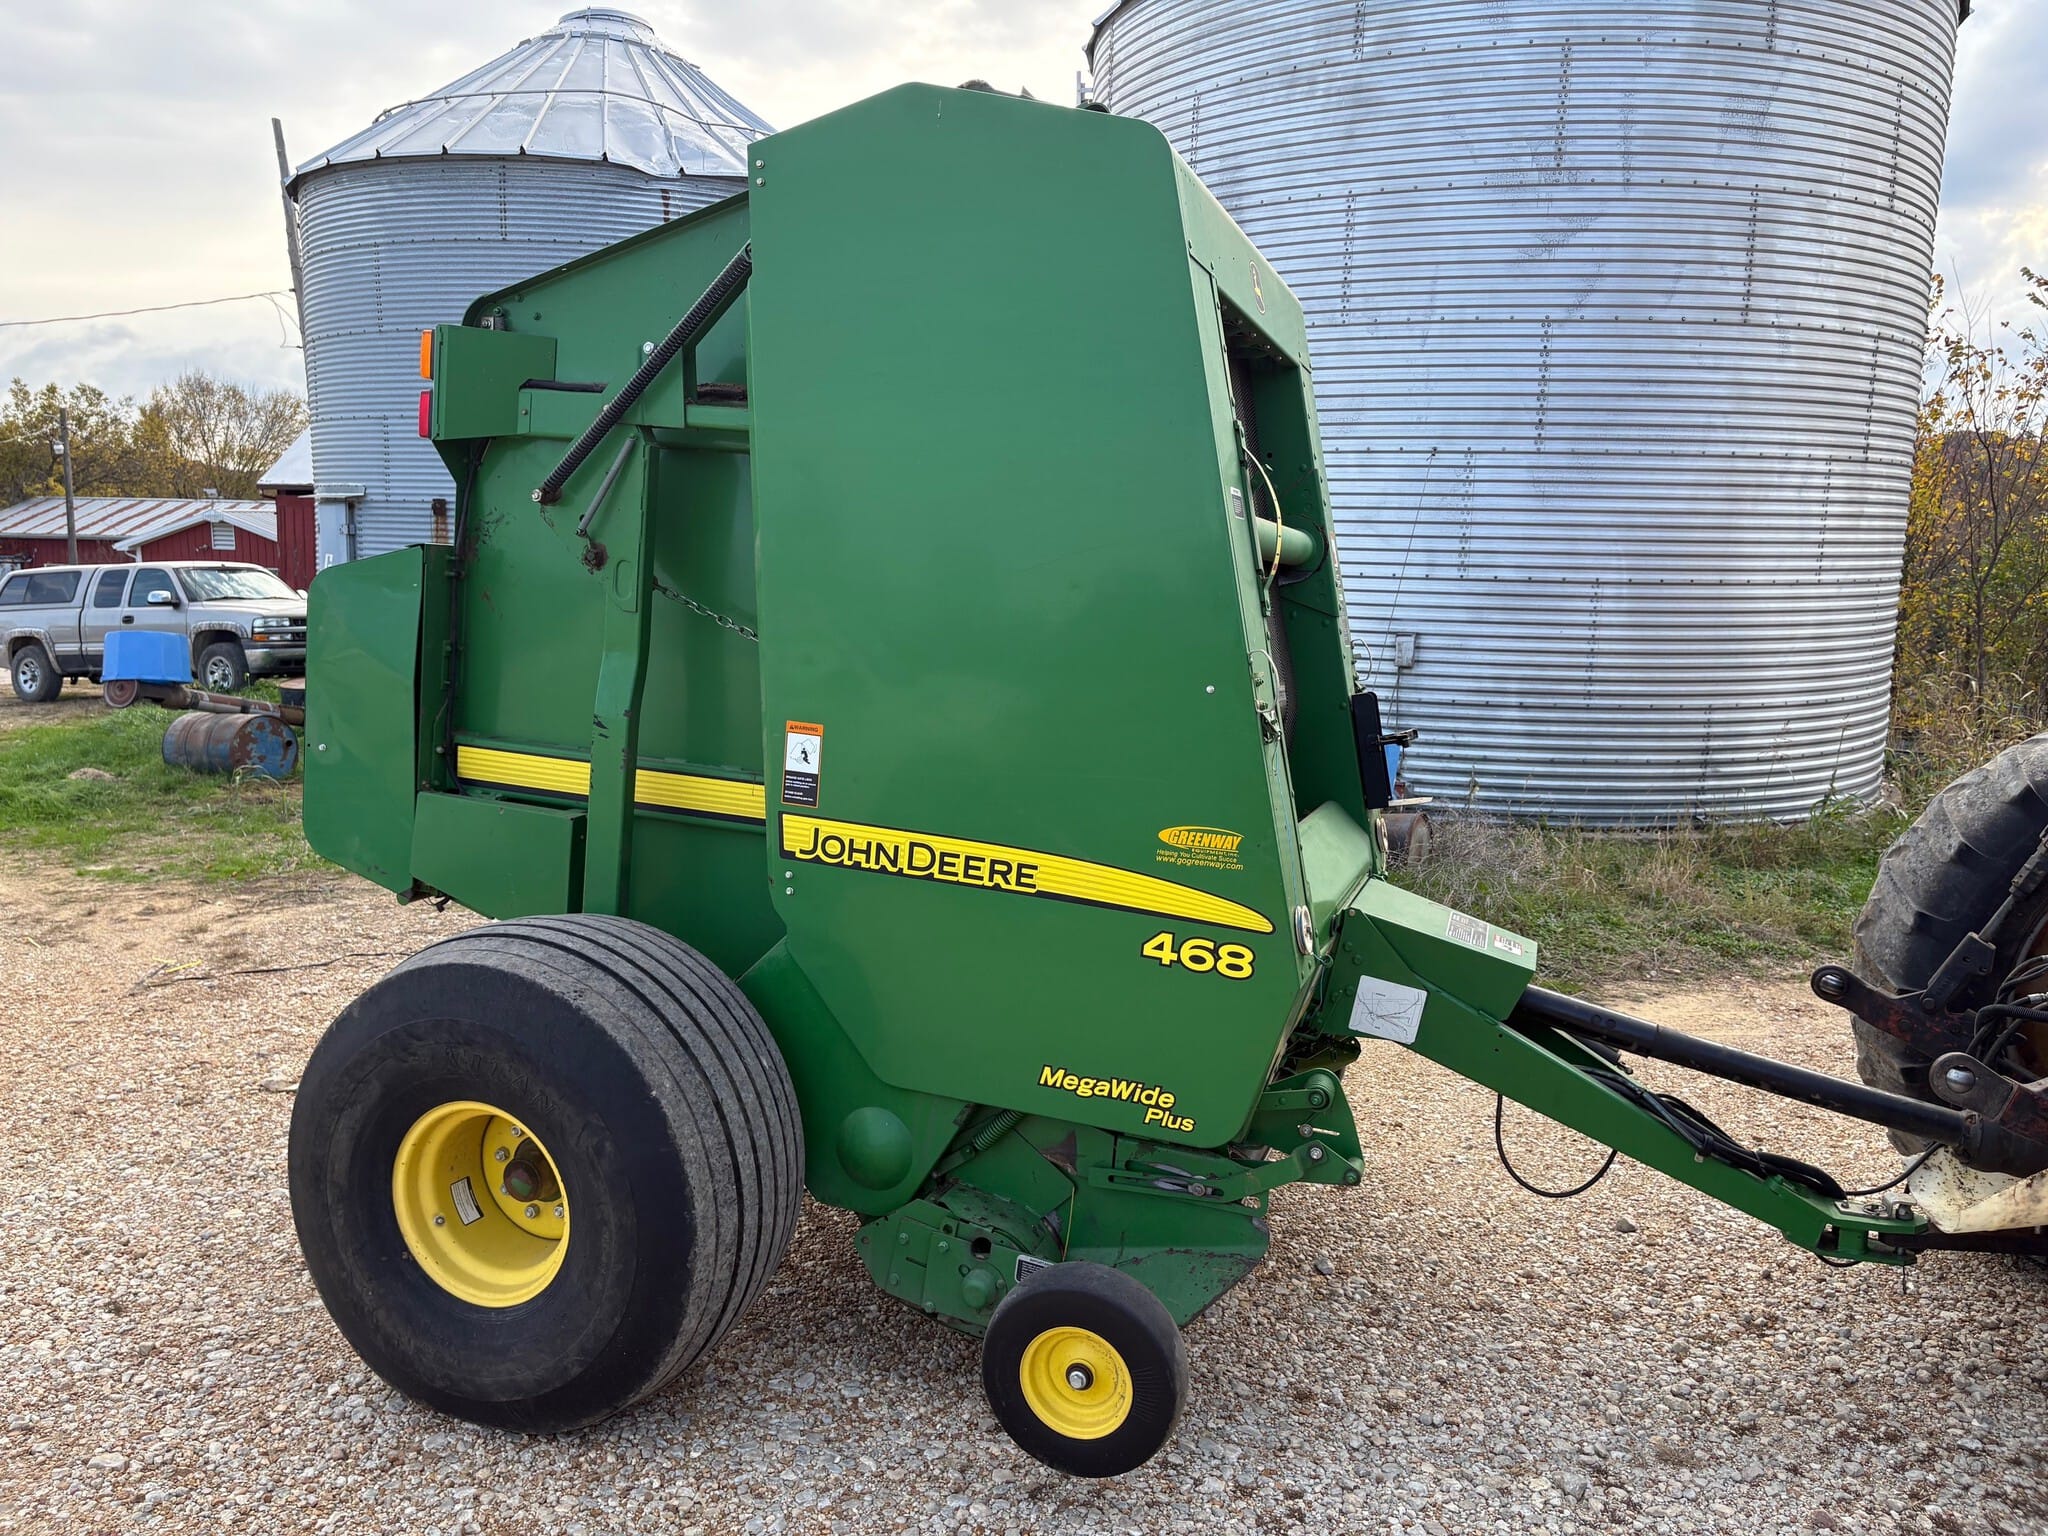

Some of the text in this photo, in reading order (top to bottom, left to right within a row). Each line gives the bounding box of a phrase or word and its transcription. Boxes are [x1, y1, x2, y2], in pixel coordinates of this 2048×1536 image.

[1169, 830, 1242, 850] GREENWAY
[799, 827, 1039, 890] JOHN DEERE
[1156, 848, 1178, 857] Helping
[1191, 852, 1217, 861] Cultivate
[1156, 855, 1244, 870] www.gogreenway.com
[1141, 931, 1255, 979] 468
[1038, 1065, 1176, 1109] MegaWide
[1143, 1106, 1196, 1133] Plus
